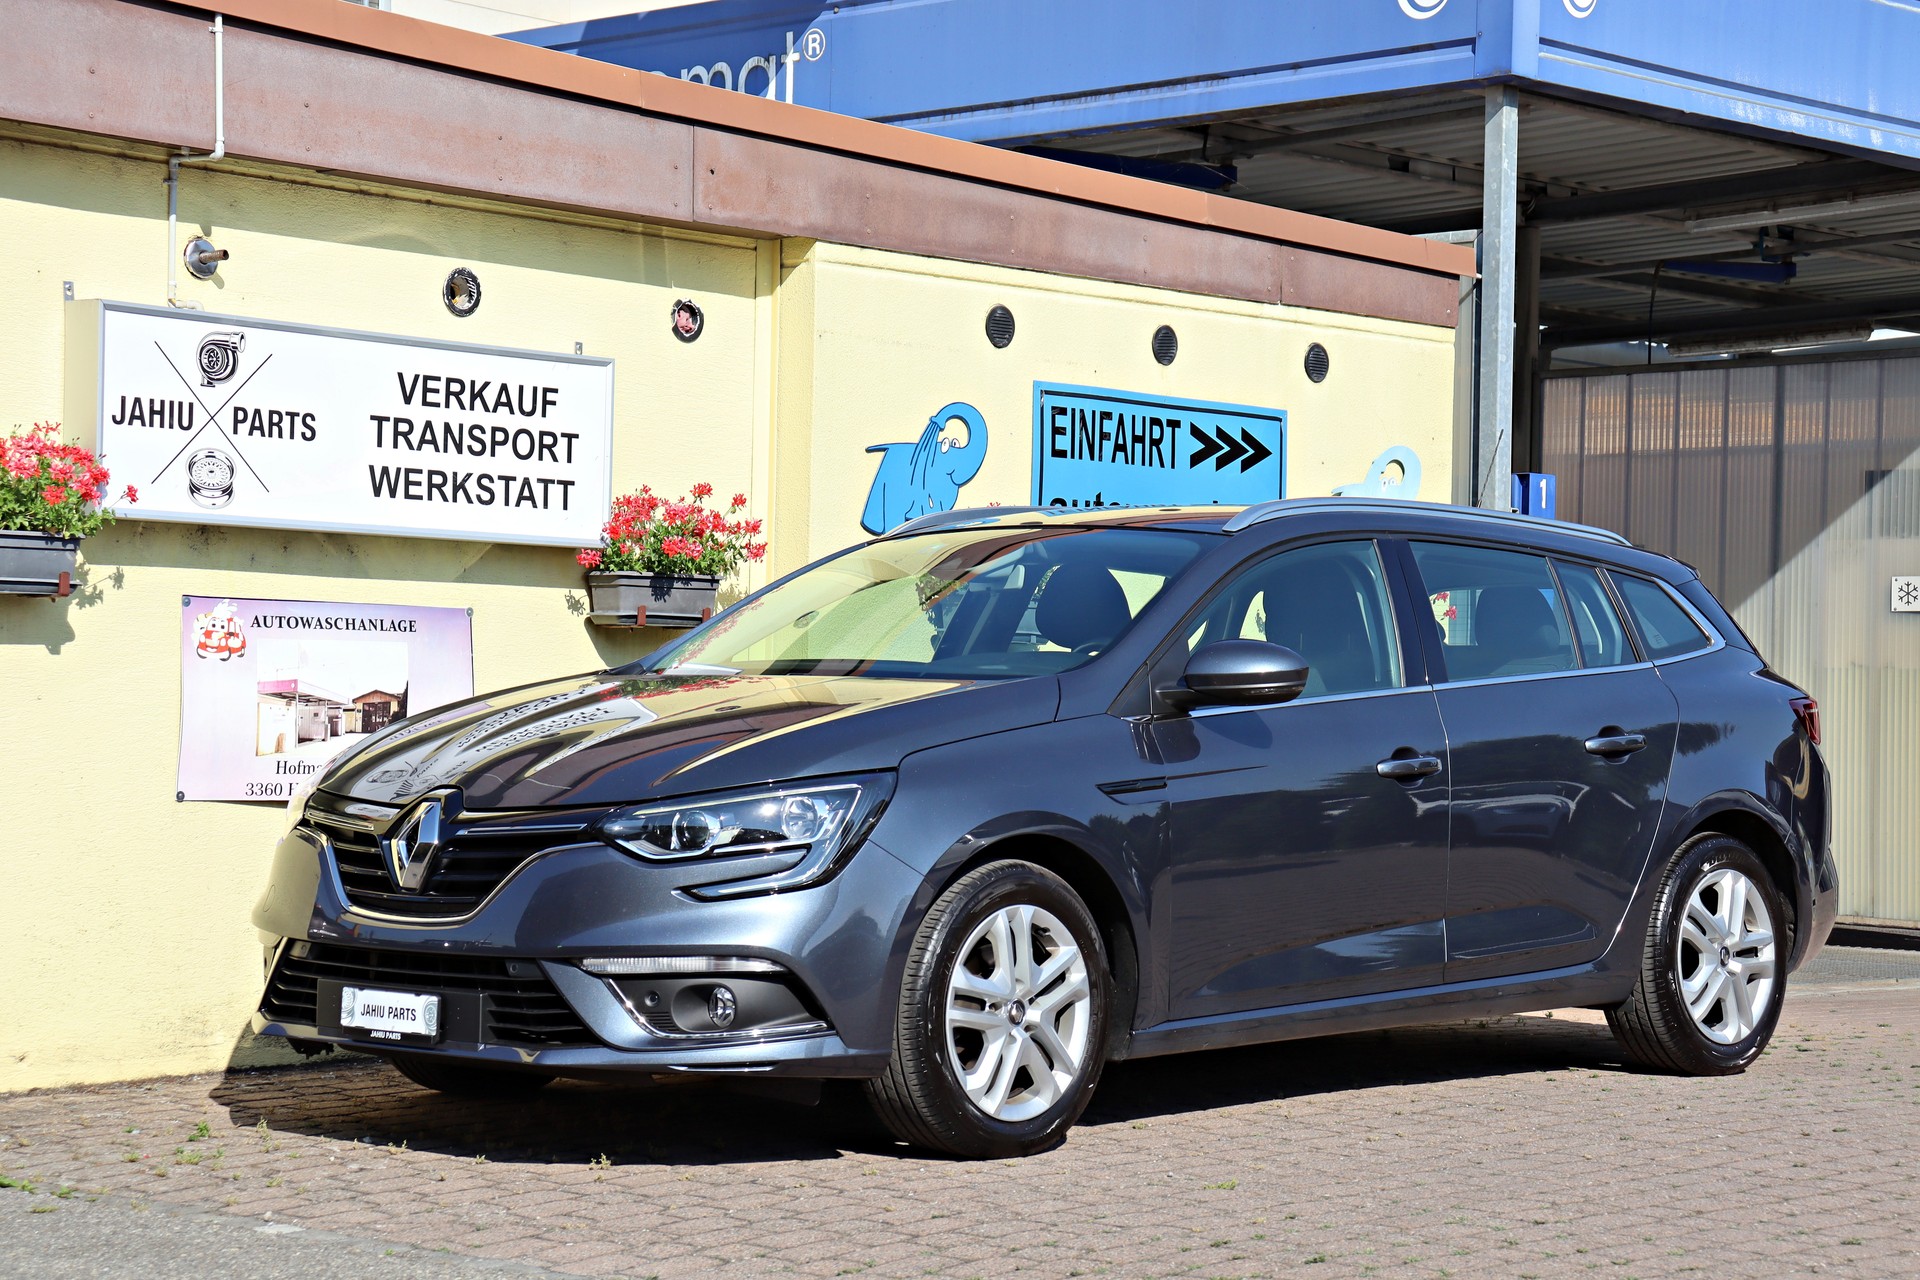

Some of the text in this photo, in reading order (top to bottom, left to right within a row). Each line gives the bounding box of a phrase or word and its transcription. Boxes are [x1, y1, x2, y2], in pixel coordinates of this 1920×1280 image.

[397, 371, 559, 418] VERKAUF
[112, 396, 317, 442] JAHIU PARTS
[370, 414, 580, 464] TRANSPORT
[1051, 406, 1181, 469] EINFAHRT
[368, 464, 576, 511] WERKSTATT
[1539, 478, 1547, 509] 1
[250, 615, 417, 633] AUTOWASCHANLAGE
[275, 760, 323, 775] Hofm
[245, 782, 283, 797] 3360
[361, 1004, 416, 1021] JAHIU PARTS
[370, 1030, 401, 1040] JAHIU PARTS
